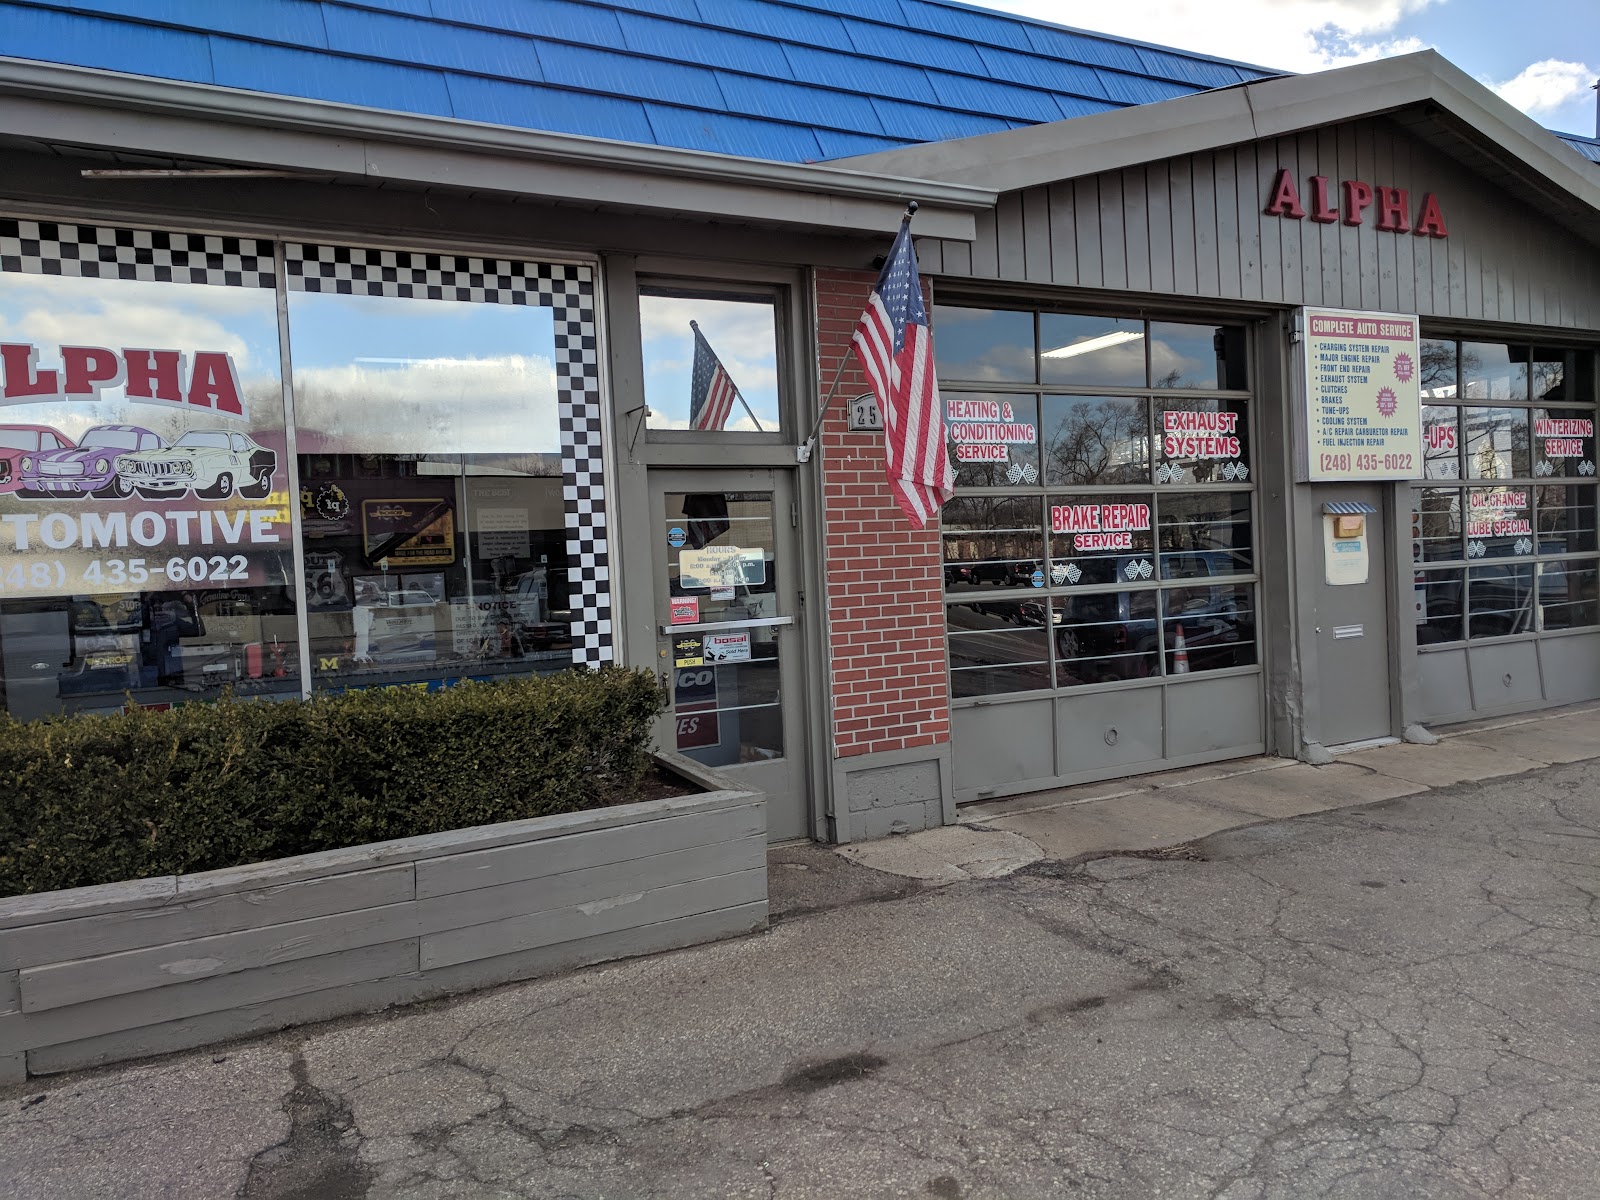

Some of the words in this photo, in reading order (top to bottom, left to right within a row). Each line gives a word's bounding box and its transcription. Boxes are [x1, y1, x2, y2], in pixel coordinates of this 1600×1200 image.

[1264, 168, 1449, 239] ALPHA
[1312, 319, 1354, 334] COMPLETE
[1357, 322, 1378, 336] AUTO
[1380, 323, 1412, 338] SERVICE
[1320, 342, 1347, 352] CHARGING
[1349, 344, 1370, 353] SYSTEM
[1372, 345, 1390, 354] REPAIR
[1320, 353, 1339, 362] MAJOR
[1341, 354, 1360, 363] ENGINE
[1362, 355, 1381, 364] REPAIR
[1320, 364, 1338, 372] FRONT
[1340, 364, 1350, 373] END
[1352, 365, 1371, 374] REPAIR
[0, 343, 246, 418] LPHA
[1321, 374, 1345, 383] EXHAUST
[1347, 375, 1368, 384] SYSTEM
[1321, 385, 1348, 394] CLUTCHES
[1321, 396, 1343, 404] BRAKES
[857, 404, 877, 425] 25
[947, 400, 999, 419] HEATING
[1002, 401, 1013, 419] &
[1322, 406, 1350, 415] TUNE-UPS
[1164, 411, 1237, 432] EXHAUST
[1322, 417, 1345, 425] COOLING
[1347, 417, 1368, 426] SYSTEM
[1534, 418, 1593, 436] WINTERIZING
[950, 422, 1035, 442] CONDITIONING
[1323, 427, 1333, 436] A/C
[1335, 427, 1354, 436] REPAIR
[1355, 427, 1389, 436] CARBURETOR
[1391, 427, 1409, 436] REPAIR
[1164, 436, 1240, 456] SYSTEMS
[1322, 438, 1336, 447] FUEL
[1338, 438, 1365, 447] INJECTION
[1366, 438, 1385, 447] REPAIR
[1545, 439, 1583, 456] SERVICE
[957, 445, 1006, 460] SERVICE
[1320, 452, 1352, 472] (248)
[1356, 453, 1413, 471] 435-6022
[1471, 493, 1486, 508] OIL
[1489, 492, 1526, 507] CHANGE
[1051, 505, 1099, 531] BRAKE
[1101, 504, 1149, 529] REPAIR
[2, 509, 280, 550] TOMOTIVE
[1467, 522, 1491, 536] LUBE
[1493, 519, 1531, 535] SPECIAL
[1074, 533, 1130, 549] SERVICE
[706, 546, 737, 554] HOURS
[0, 560, 66, 590] 48)
[82, 554, 249, 585] 435-6022
[714, 635, 747, 645] bosal
[320, 657, 339, 671] M
